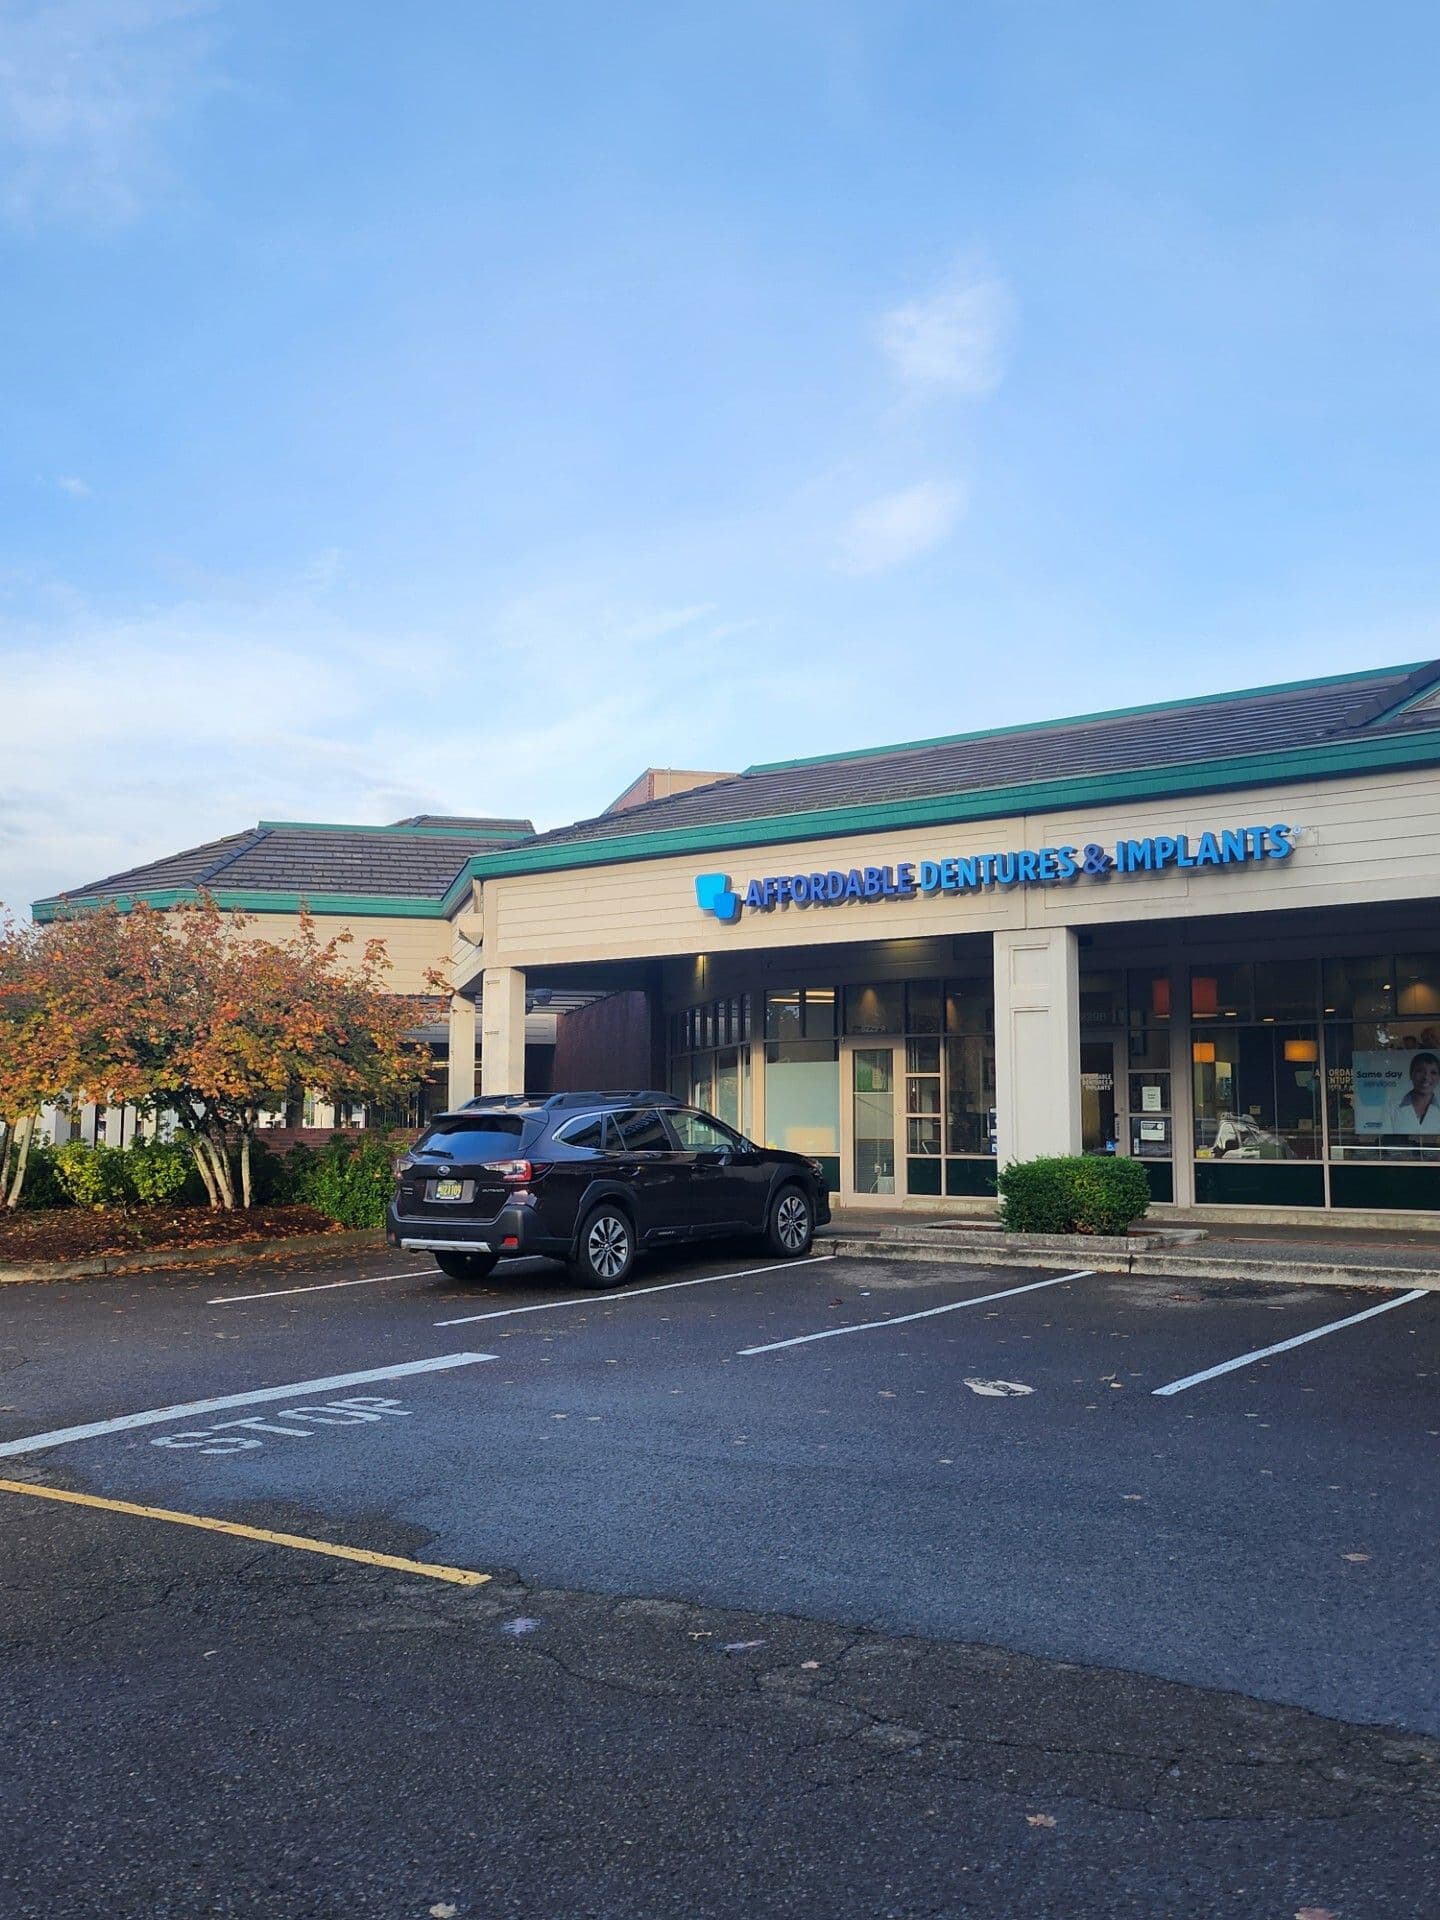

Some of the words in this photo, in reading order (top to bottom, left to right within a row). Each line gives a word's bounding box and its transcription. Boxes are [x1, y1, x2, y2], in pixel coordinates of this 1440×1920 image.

[744, 862, 917, 908] AFFORDABLE
[920, 846, 1077, 892] DENTURES
[1082, 842, 1114, 875] &
[1116, 823, 1294, 873] IMPLANTS
[1356, 1070, 1383, 1079] Same
[1385, 1070, 1403, 1081] day
[150, 1396, 413, 1455] STOP
